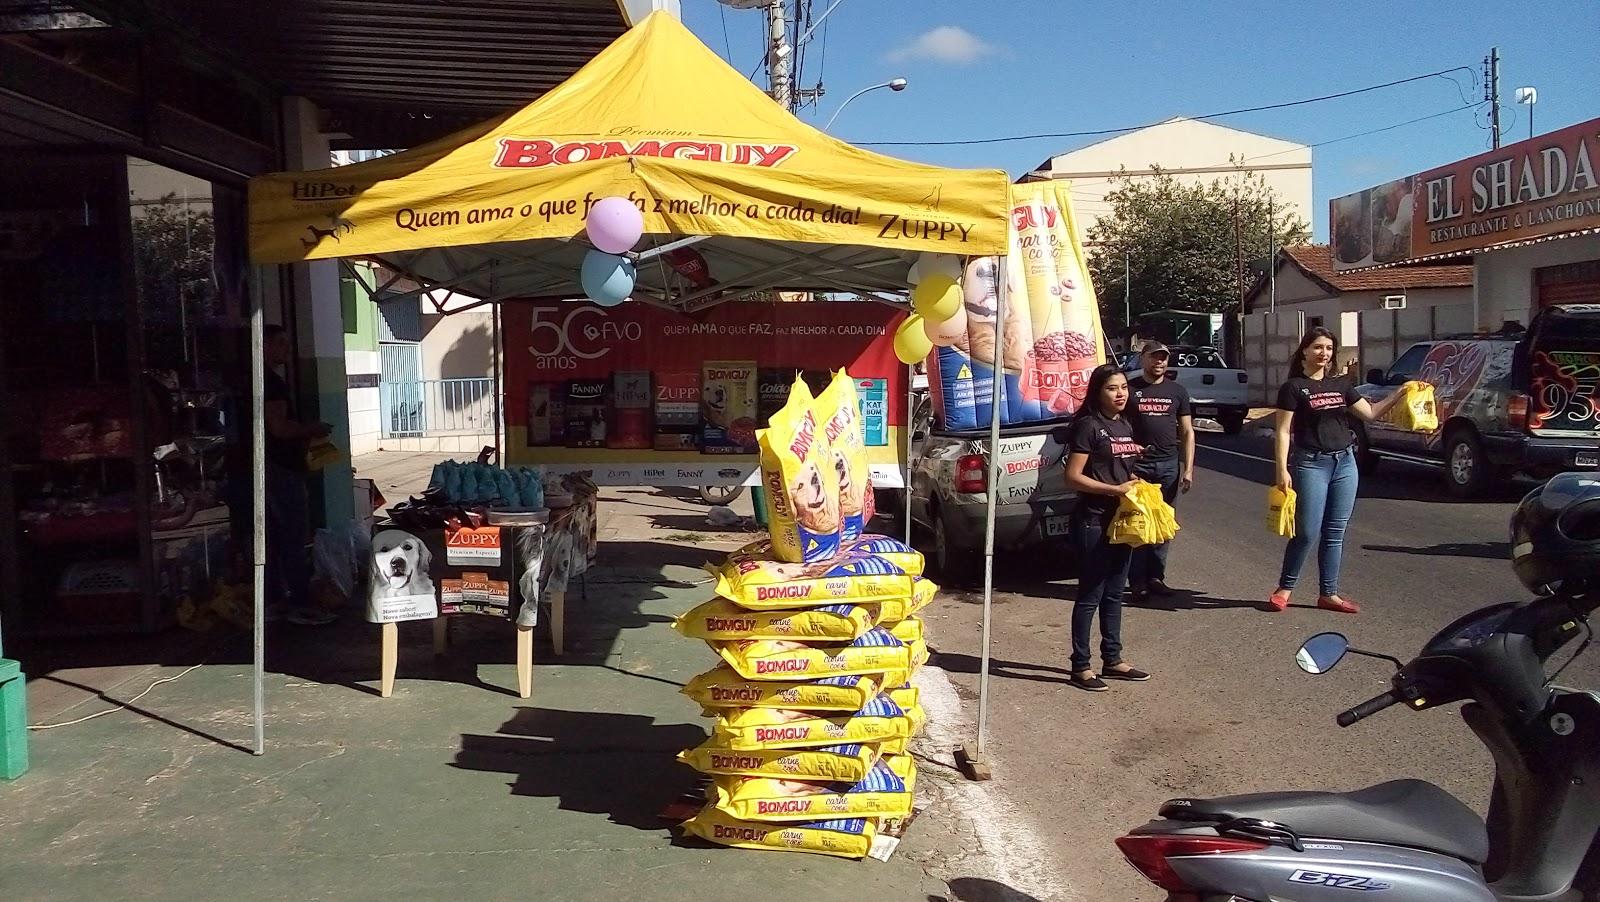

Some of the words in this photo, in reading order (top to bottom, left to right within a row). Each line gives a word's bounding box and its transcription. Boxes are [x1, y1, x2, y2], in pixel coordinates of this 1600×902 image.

[604, 126, 694, 137] Premium
[493, 138, 797, 169] BOMGUY
[292, 181, 359, 198] HiPet
[1426, 175, 1464, 224] EL
[395, 208, 460, 231] Quem
[466, 206, 514, 225] ama
[520, 204, 532, 217] o
[538, 199, 577, 222] que
[669, 195, 740, 217] melhor
[745, 204, 759, 218] a
[765, 202, 815, 223] cada
[821, 203, 861, 226] dia!
[1008, 204, 1058, 233] GUY
[877, 213, 977, 243] ZUPPY
[1430, 216, 1508, 243] RESTAURANTE
[1514, 213, 1522, 227] &
[663, 325, 690, 336] QUEM
[691, 323, 718, 334] AMA
[719, 325, 726, 335] O
[728, 325, 747, 335] QUE
[791, 326, 827, 335] MELHOR
[829, 326, 836, 335] A
[837, 325, 864, 336] CADA
[536, 357, 577, 370] anos
[1177, 353, 1199, 368] 50
[708, 370, 752, 381] BOMGUY
[1029, 367, 1092, 388] BOMGU
[571, 383, 605, 394] FANNY
[760, 382, 790, 395] Coldo
[866, 401, 883, 409] KAT
[1000, 441, 1033, 454] ZUPPY
[644, 469, 666, 477] HiPet
[1006, 456, 1051, 475] BOMGUY
[677, 469, 704, 478] FANNY
[449, 531, 499, 545] ZUPPY
[756, 584, 812, 601] BOMGUY
[706, 615, 757, 632] BOMGUY
[756, 658, 810, 673] BOMGUY
[711, 686, 763, 701] BOMGUY
[756, 727, 810, 741] BOMGUY
[711, 755, 764, 769] BOMGUY
[758, 800, 812, 814] BOMGUY
[713, 824, 768, 841] BOMGUY
